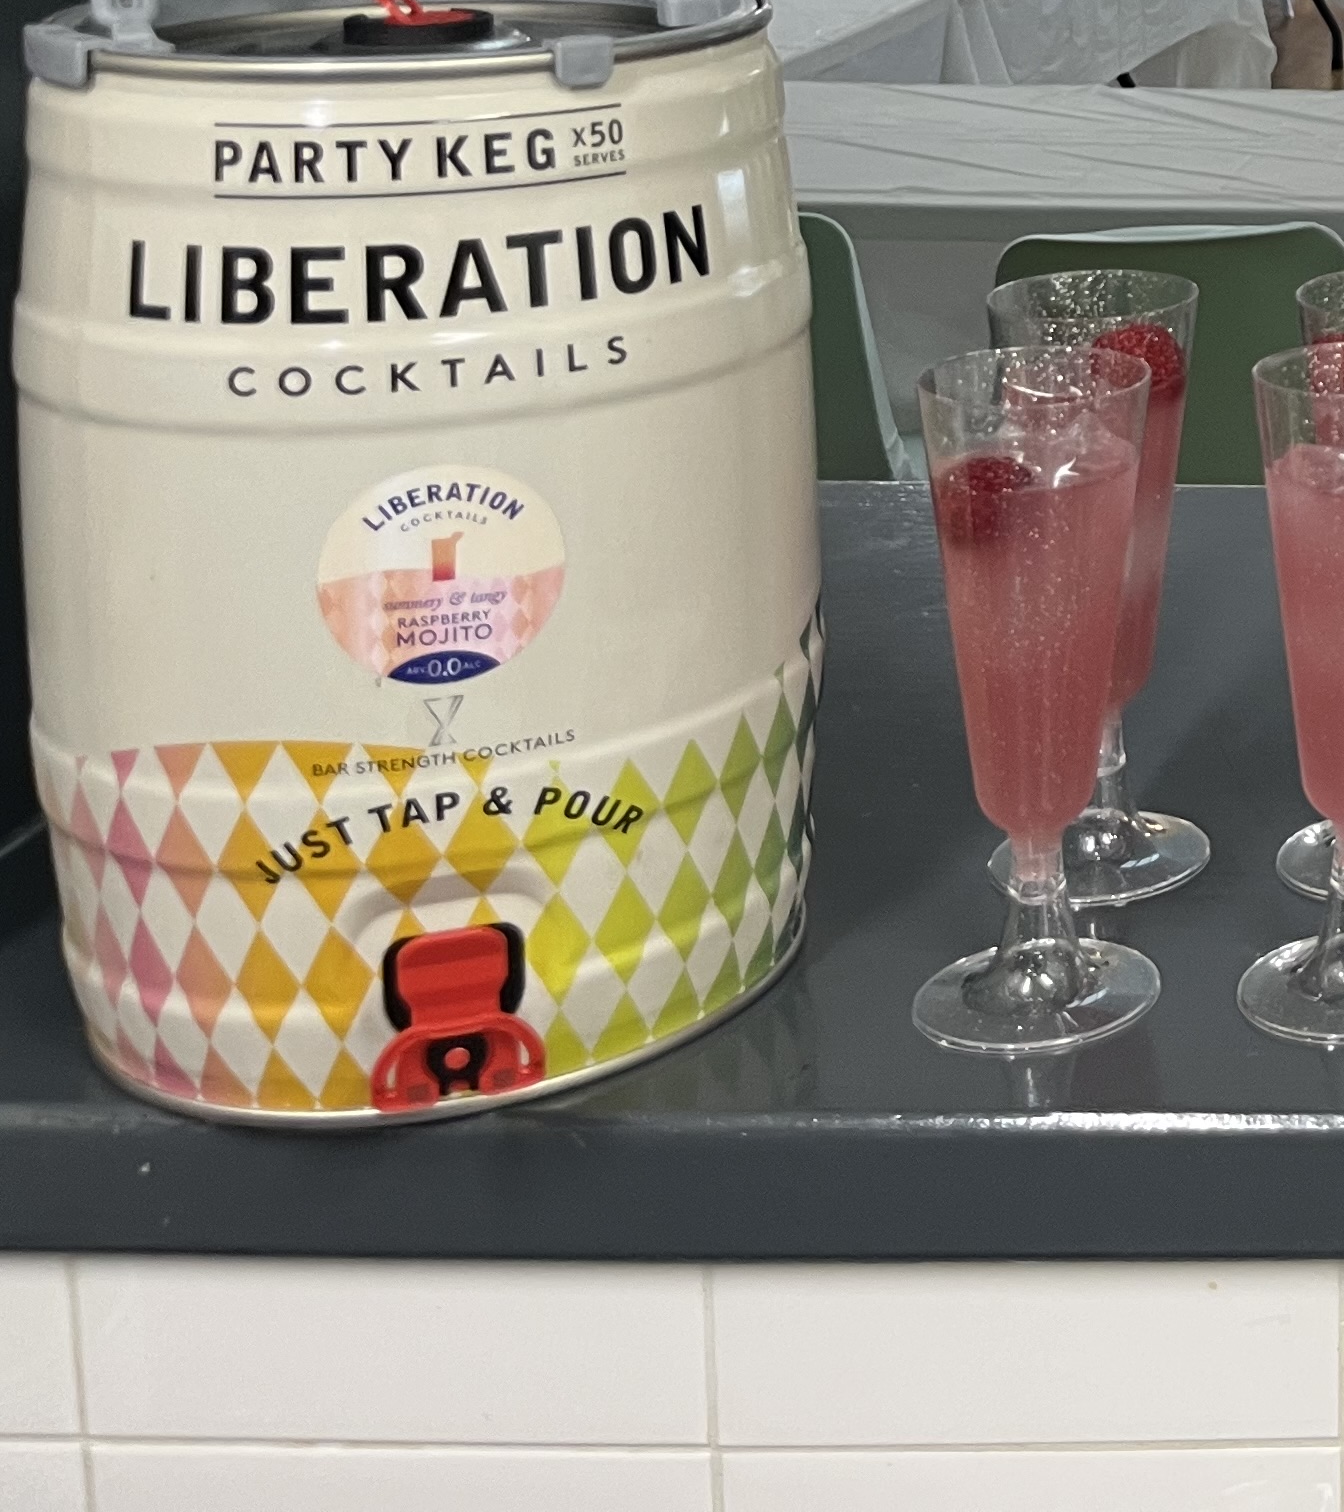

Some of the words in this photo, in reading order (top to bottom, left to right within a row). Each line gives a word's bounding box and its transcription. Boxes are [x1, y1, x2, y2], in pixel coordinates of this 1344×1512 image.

[213, 137, 413, 184] PARTY
[436, 127, 557, 178] KEG
[573, 148, 626, 168] SERVES
[128, 203, 710, 325] LIBERATION
[226, 335, 629, 397] COCKTAILS
[362, 482, 525, 532] LIBERATION
[400, 510, 489, 533] COCKTAILS
[396, 623, 493, 647] MOJITO
[397, 609, 492, 629] RASPBERRY
[427, 657, 462, 678] 0.0
[311, 761, 350, 778] BAR
[355, 751, 457, 776] STRENGTH
[463, 728, 577, 764] COCKTAILS
[255, 815, 354, 886] JUST
[367, 790, 461, 834] TAP
[482, 786, 514, 817] &
[533, 785, 644, 835] POUR
